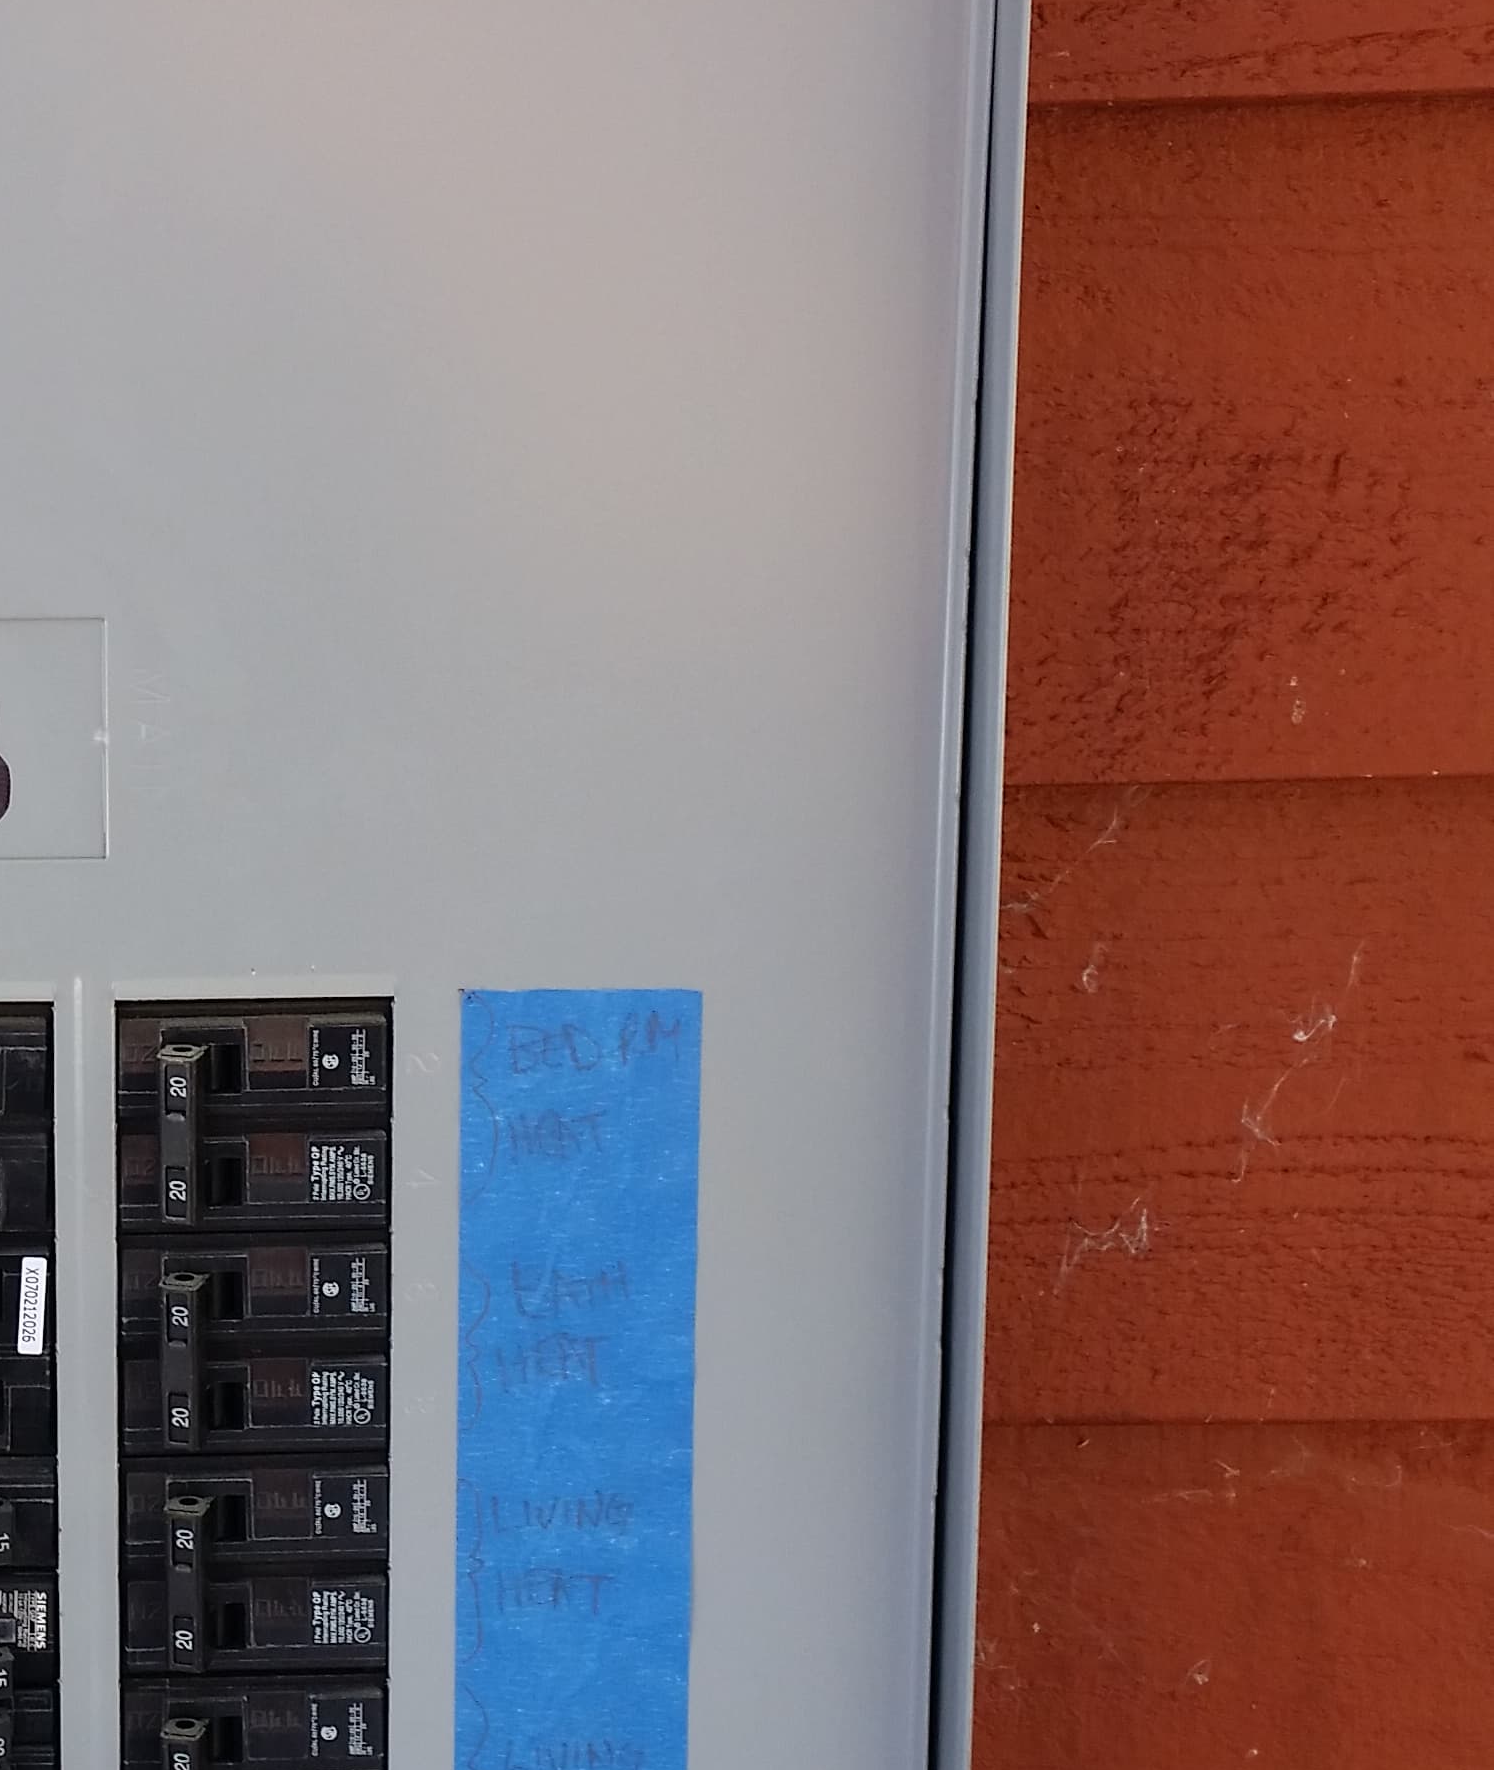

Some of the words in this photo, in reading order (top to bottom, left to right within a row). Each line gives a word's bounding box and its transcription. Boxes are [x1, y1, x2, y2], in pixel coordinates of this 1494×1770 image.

[170, 1076, 187, 1098] 20
[310, 1160, 322, 1182] Type
[169, 1180, 187, 1201] 20
[21, 1267, 39, 1343] X070212026
[171, 1305, 189, 1327] 20
[311, 1385, 323, 1407] Type
[172, 1407, 189, 1428] 20
[176, 1528, 194, 1550] 20
[35, 1592, 47, 1649] SIEMENS
[312, 1604, 323, 1626] Type
[176, 1629, 194, 1650] 20
